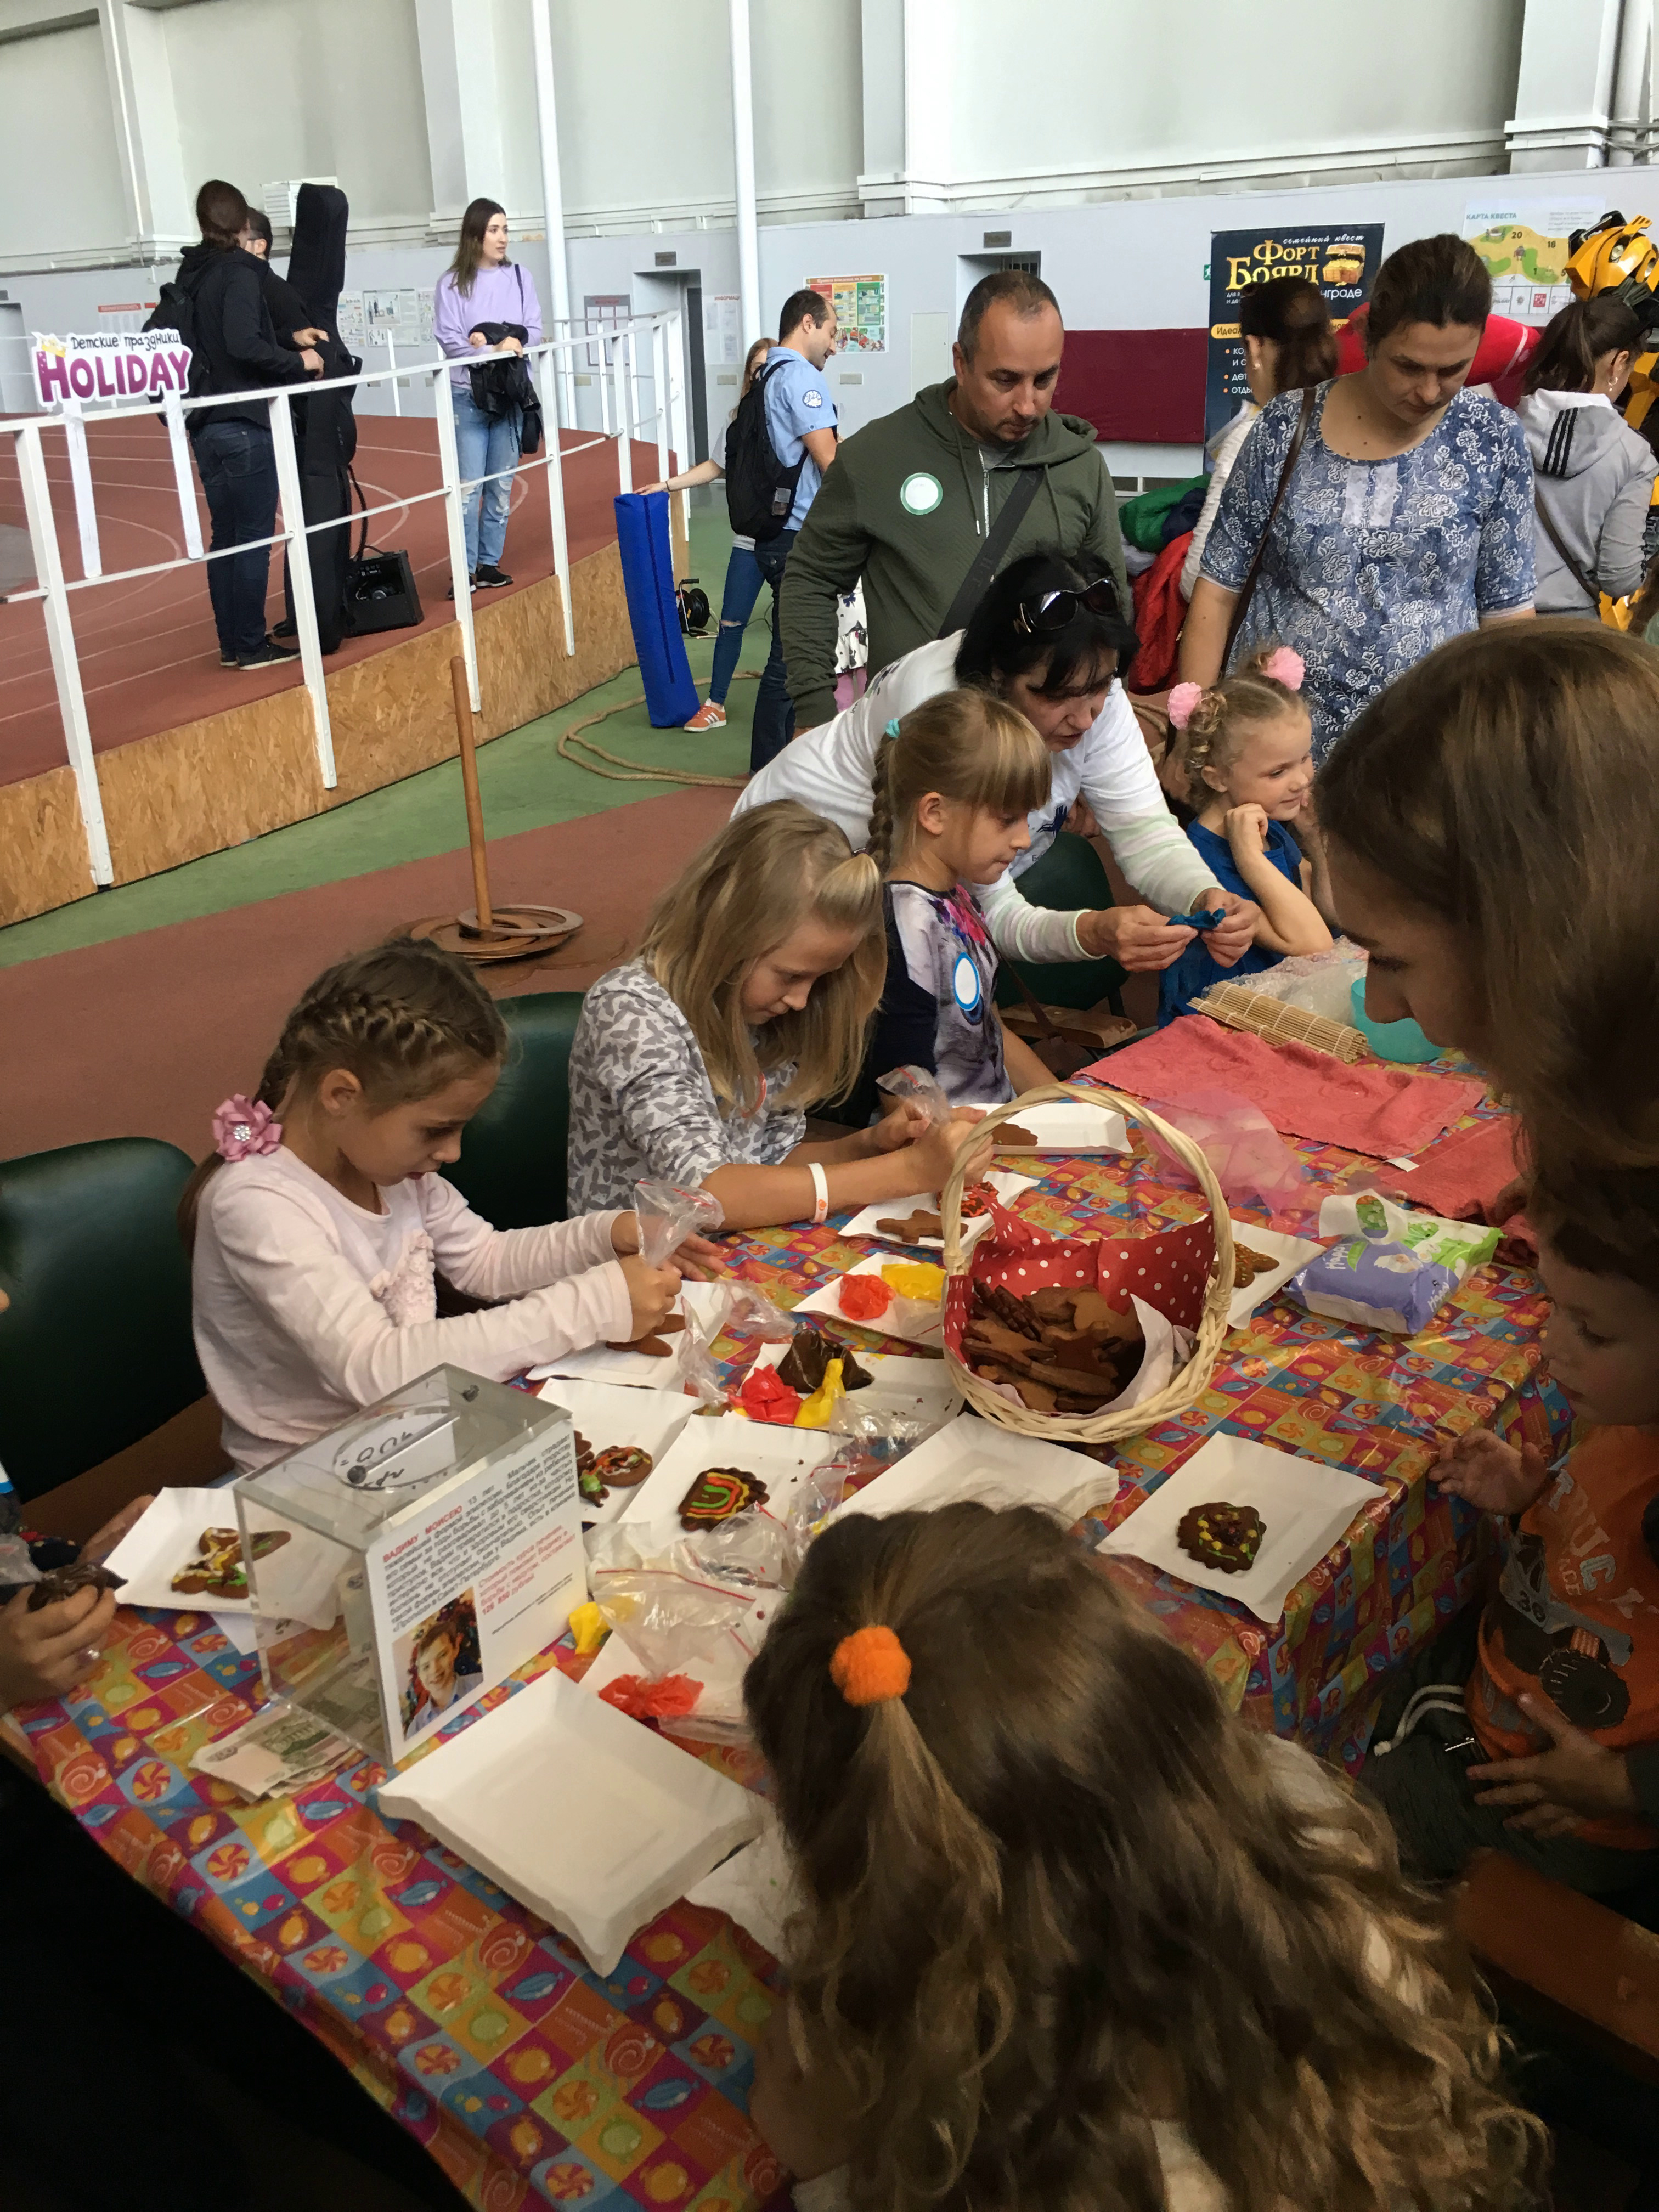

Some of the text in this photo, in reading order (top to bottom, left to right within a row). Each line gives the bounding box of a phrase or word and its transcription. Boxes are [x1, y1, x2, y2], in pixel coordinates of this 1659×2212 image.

[1283, 233, 1365, 245] семейный квест
[1511, 231, 1523, 239] 20
[1547, 240, 1556, 249] 18
[70, 332, 179, 351] Детские праздники
[36, 349, 190, 402] HOLIDAY
[383, 1534, 417, 1563] ВАДИМУ
[425, 1505, 461, 1534] МОИСЕЮ
[468, 1494, 477, 1506] 13
